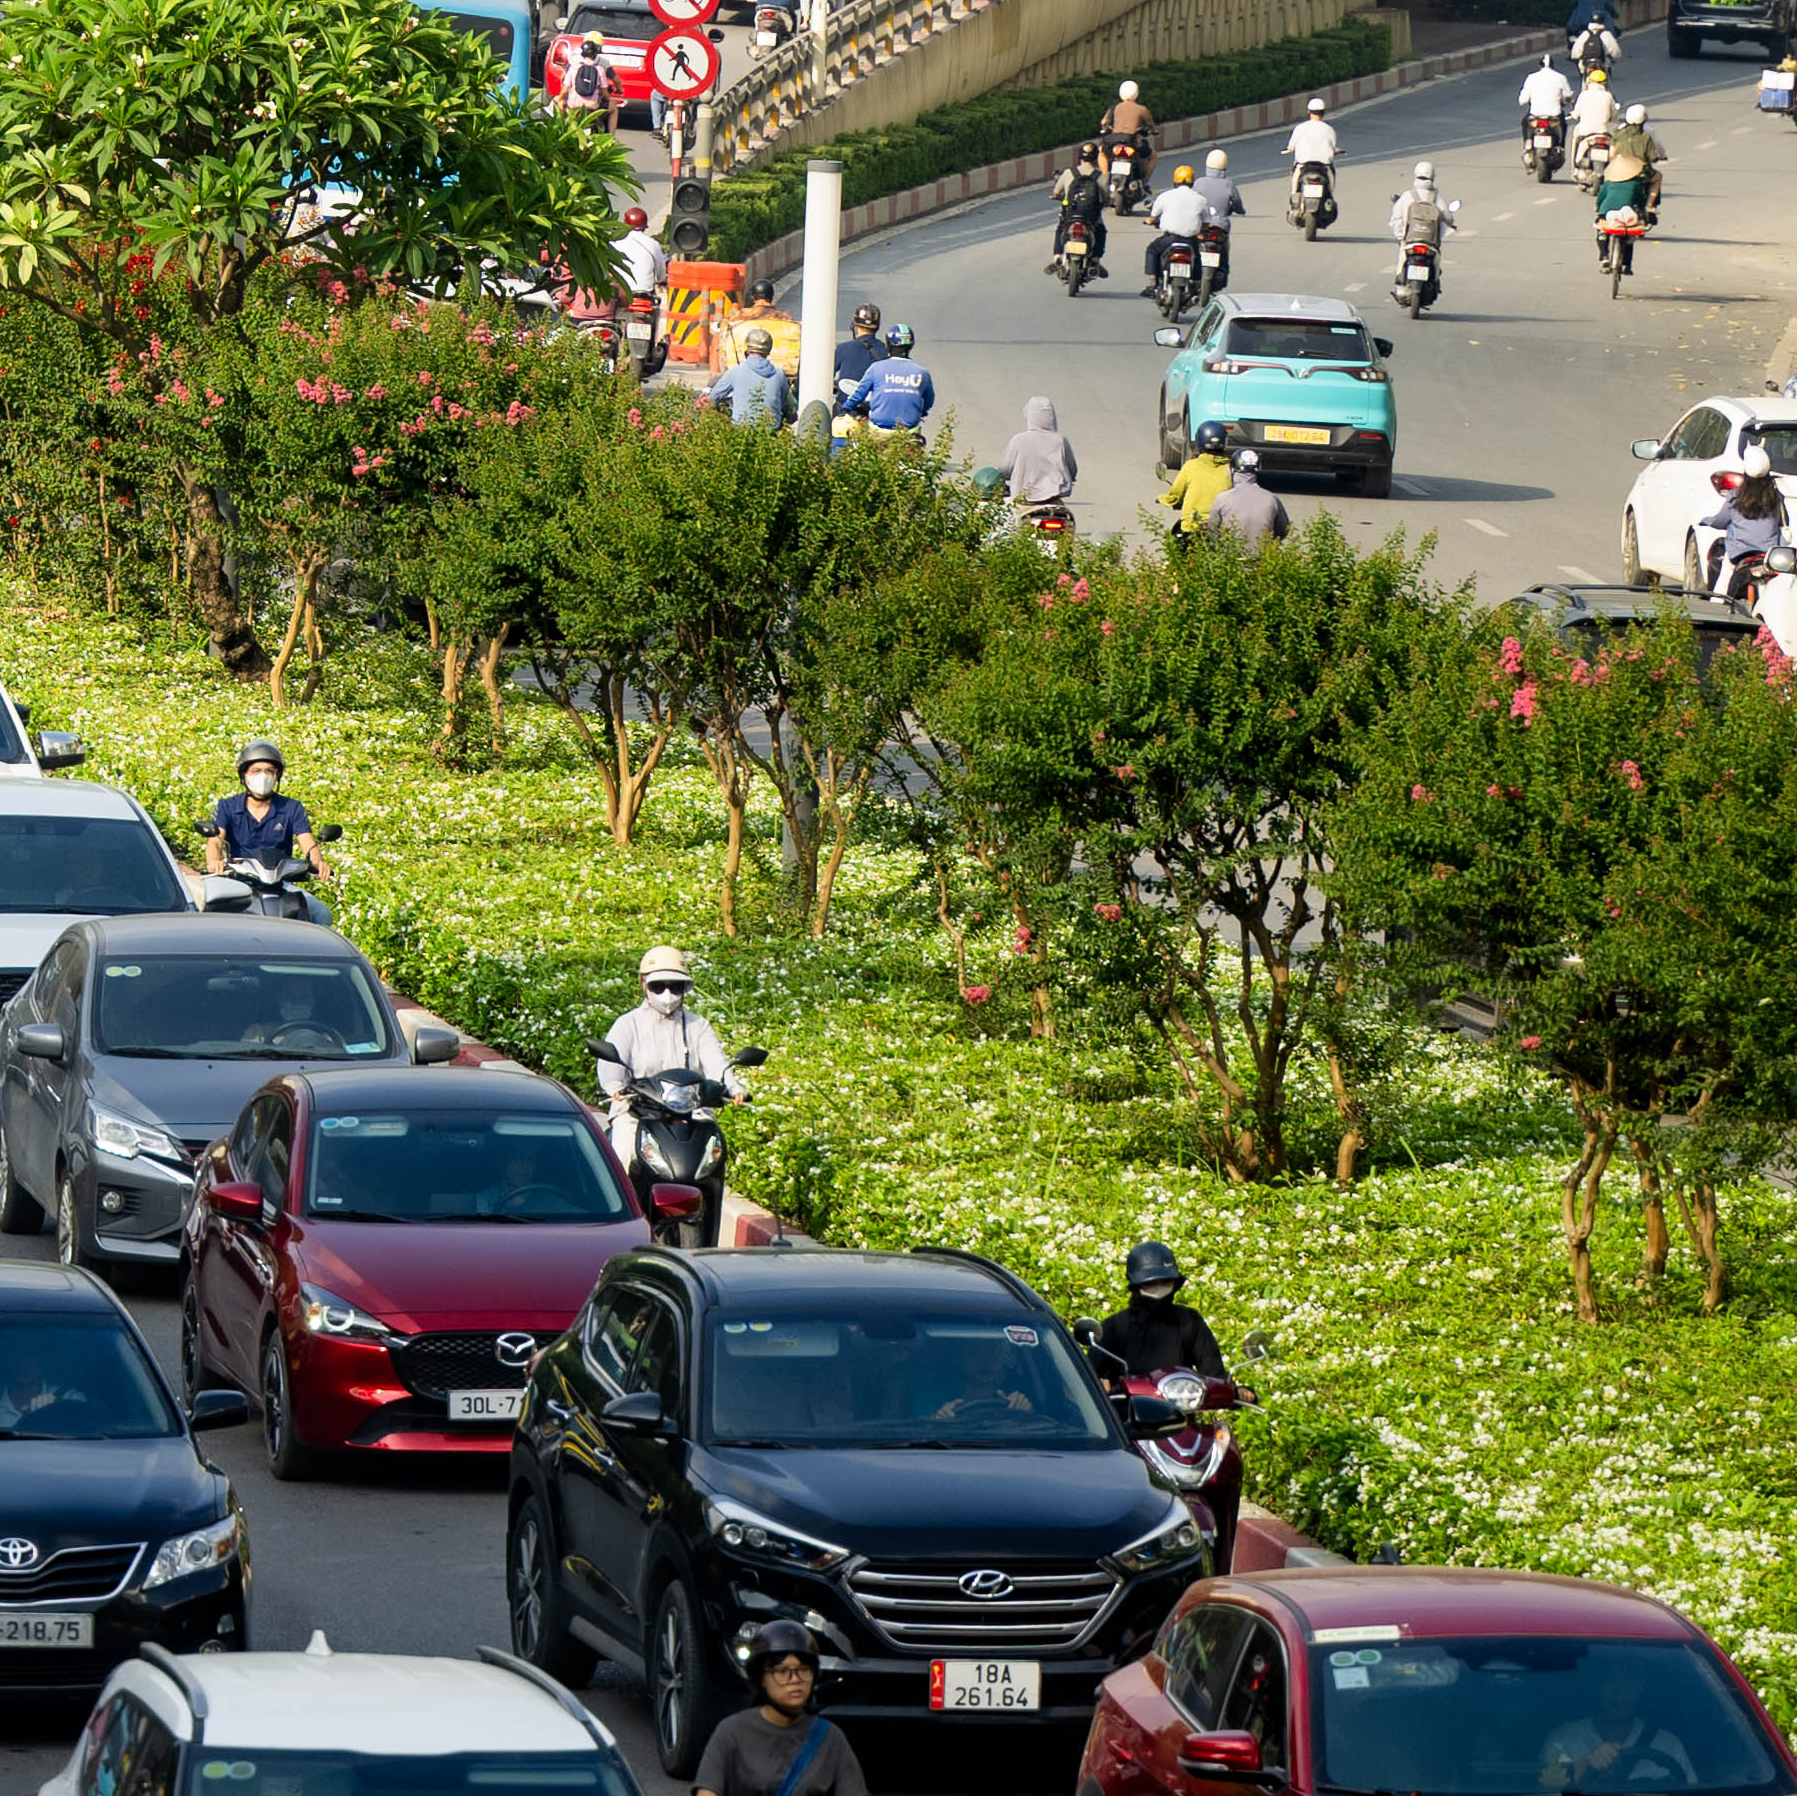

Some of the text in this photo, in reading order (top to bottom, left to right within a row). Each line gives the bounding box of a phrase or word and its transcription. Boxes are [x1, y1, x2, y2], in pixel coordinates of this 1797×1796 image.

[461, 1396, 524, 1415] 30L-7
[975, 1664, 1013, 1684] 18A
[954, 1687, 1029, 1708] 261.64
